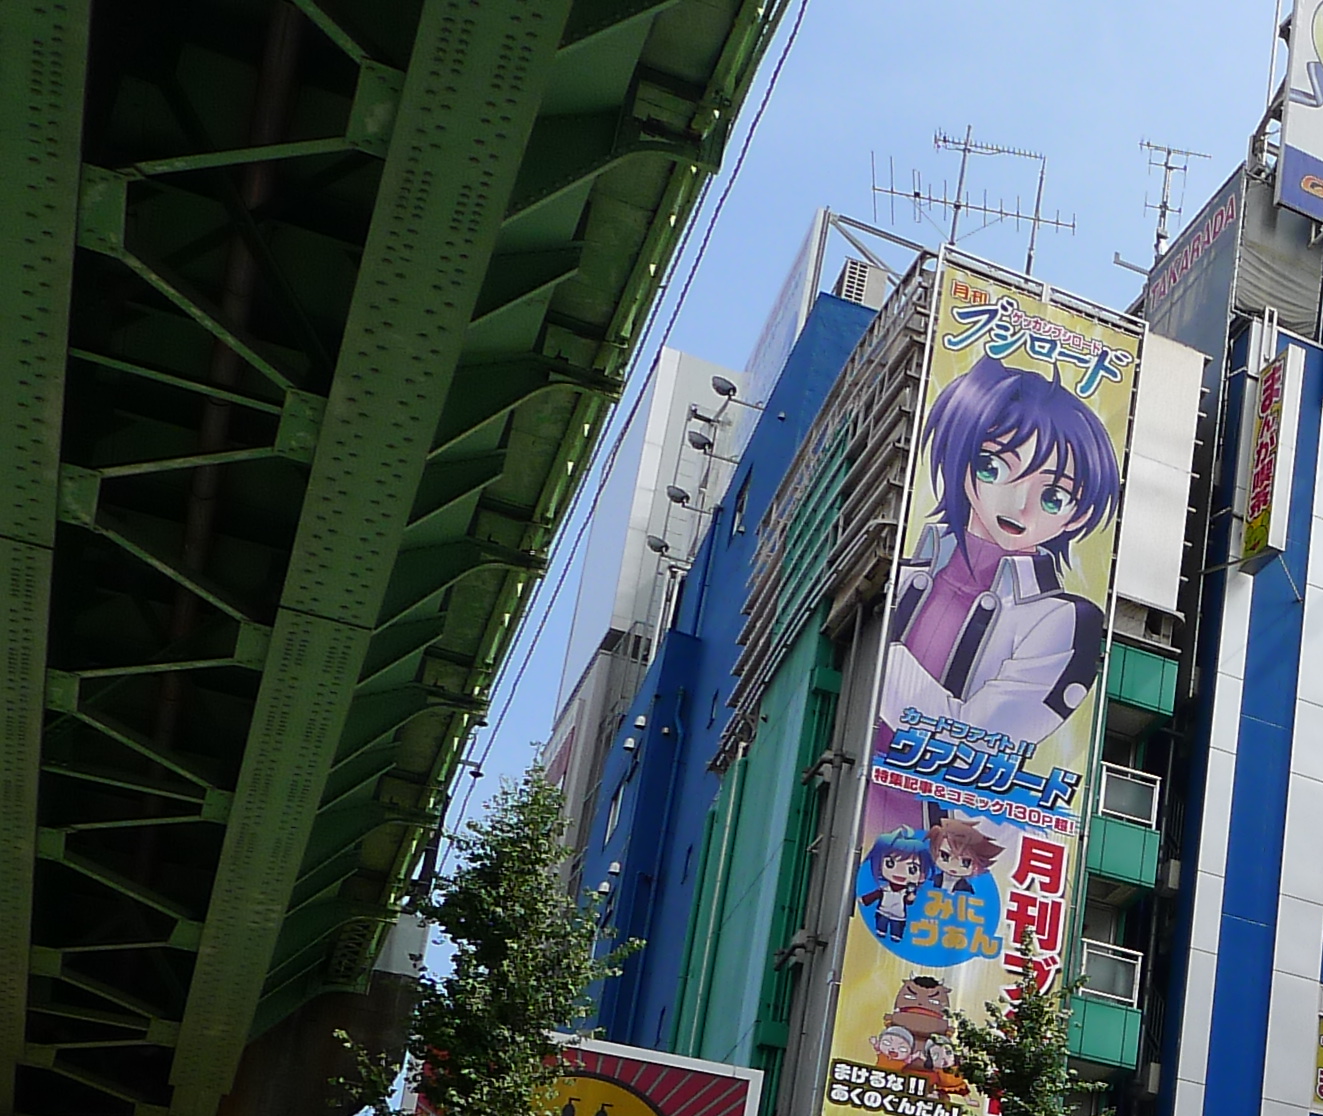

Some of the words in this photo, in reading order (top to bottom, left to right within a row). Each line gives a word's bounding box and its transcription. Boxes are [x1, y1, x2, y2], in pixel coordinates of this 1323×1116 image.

[949, 279, 989, 307] 月刊
[1247, 363, 1284, 523] まんが喫茶
[887, 724, 1084, 812] ヴァンガード
[833, 1062, 926, 1098] まけるな!!
